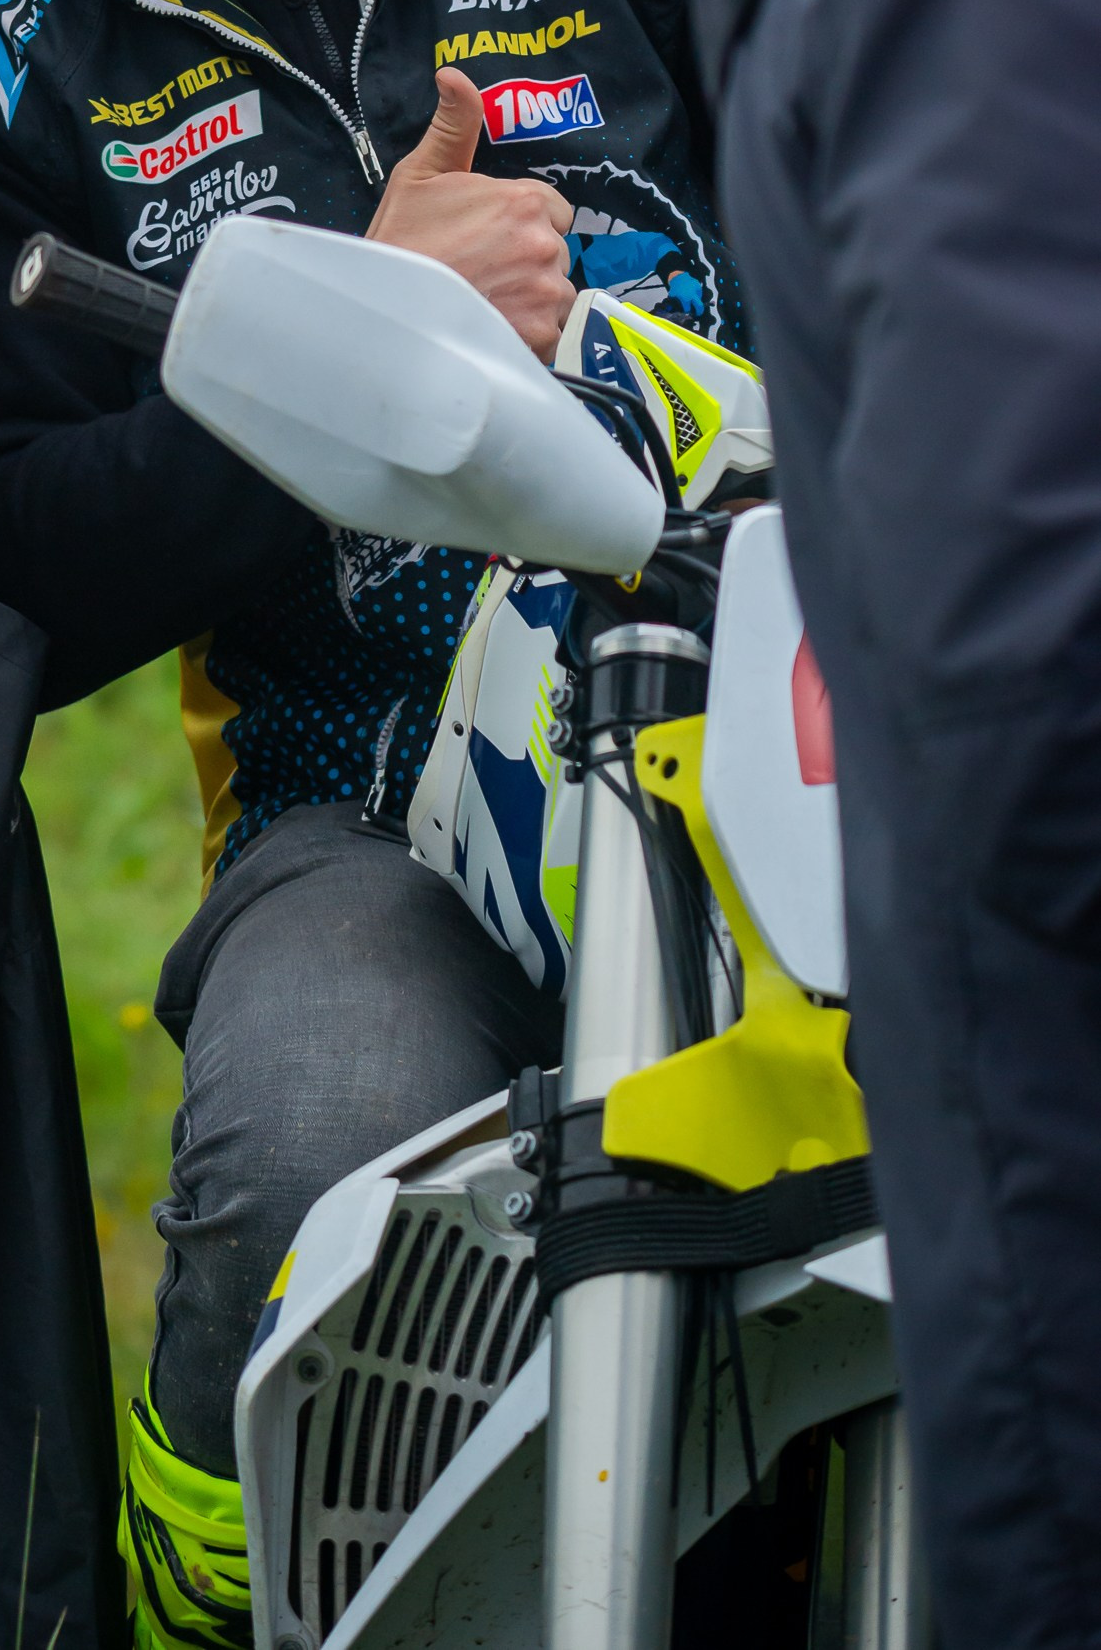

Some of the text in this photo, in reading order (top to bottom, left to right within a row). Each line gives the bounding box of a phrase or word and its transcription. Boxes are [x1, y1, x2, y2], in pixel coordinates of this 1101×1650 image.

[435, 9, 601, 69] MANNOL
[112, 80, 175, 127] BEST
[494, 81, 594, 136] 100%
[140, 103, 244, 179] Castrol
[189, 167, 222, 198] 669
